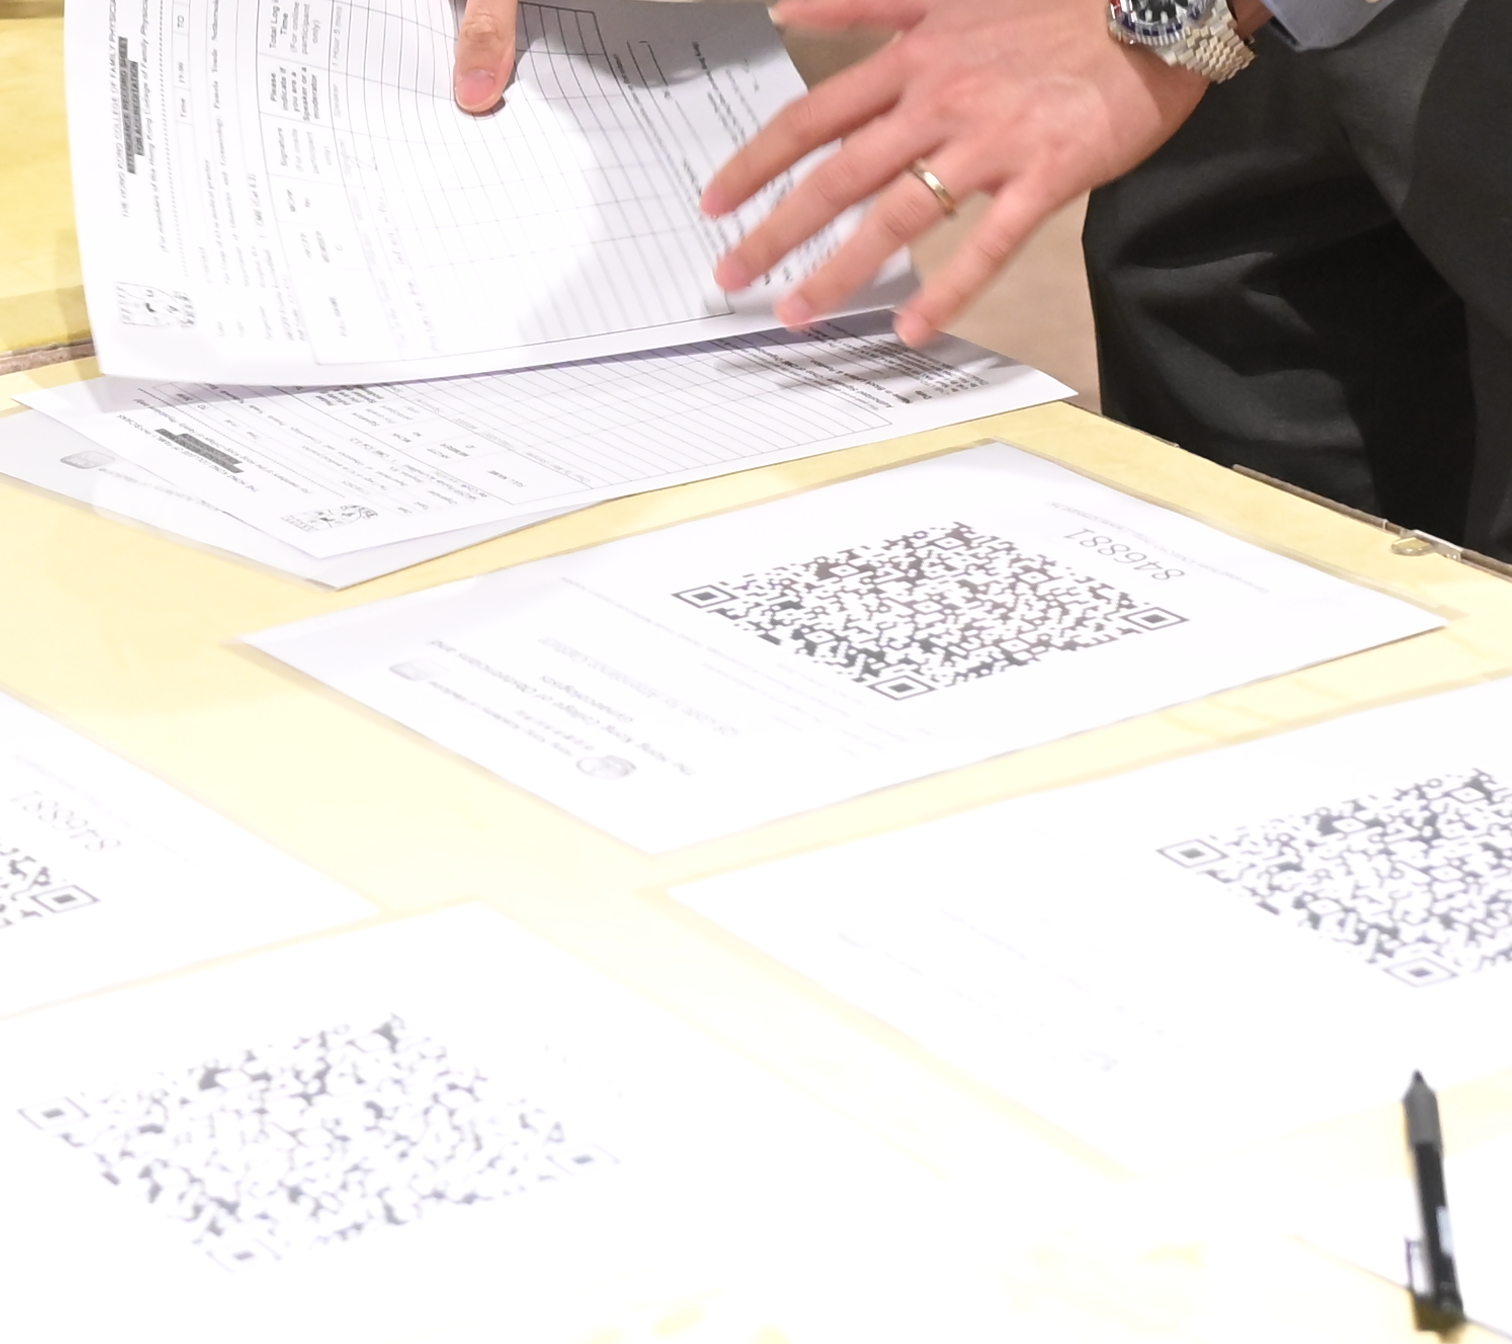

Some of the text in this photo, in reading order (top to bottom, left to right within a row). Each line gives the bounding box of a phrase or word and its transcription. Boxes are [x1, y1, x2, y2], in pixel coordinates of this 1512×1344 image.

[270, 7, 280, 24] Log
[280, 13, 289, 35] Time
[292, 2, 300, 30] online
[300, 4, 310, 54] participant
[269, 26, 278, 48] Total
[109, 44, 118, 78] FAMILY
[269, 73, 278, 101] Please
[279, 77, 288, 111] indicate
[310, 74, 320, 120] moderator
[292, 96, 300, 112] you
[301, 88, 311, 121] Speaker
[1063, 528, 1185, 581] 846881
[10, 790, 121, 852] 846881
